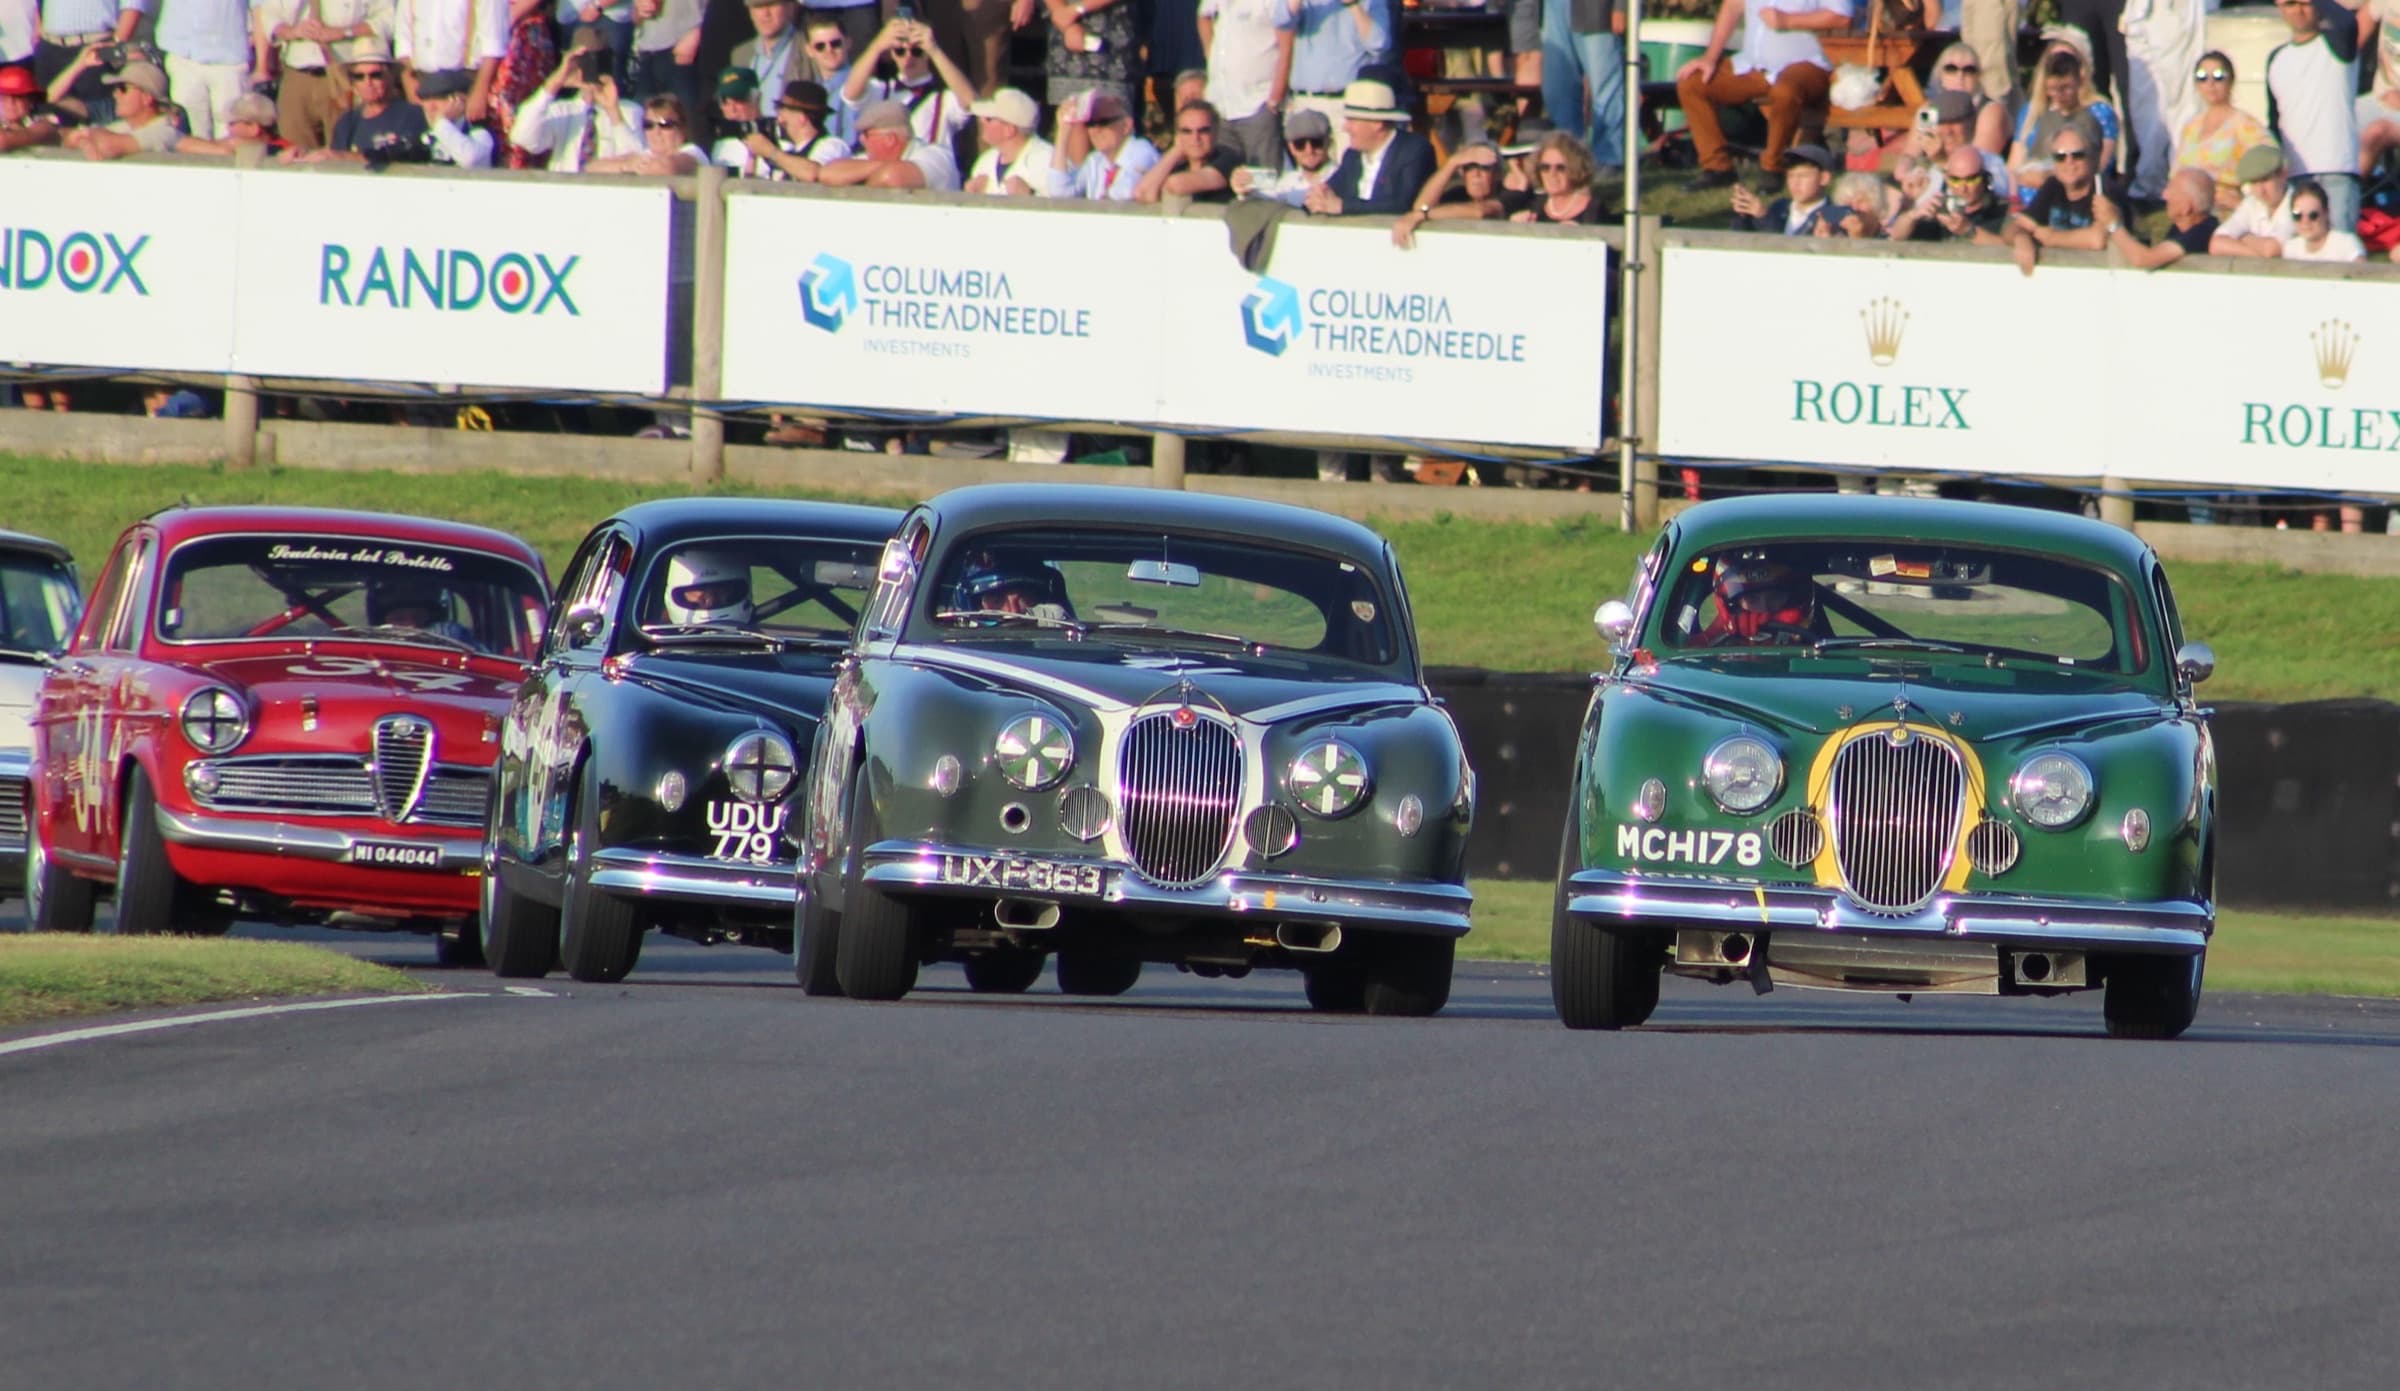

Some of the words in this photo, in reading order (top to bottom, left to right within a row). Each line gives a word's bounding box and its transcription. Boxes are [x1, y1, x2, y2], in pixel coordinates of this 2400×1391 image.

[319, 243, 581, 316] RANDOX
[863, 265, 1012, 300] COLUMBIA
[864, 299, 1091, 337] THREADNEEDLE
[1309, 289, 1452, 323] COLUMBIA
[863, 339, 971, 358] INVESTMENTS
[1309, 323, 1526, 362] THREADNEEDLE
[1308, 362, 1413, 383] INVESTMENTS
[1792, 379, 1971, 430] ROLEX
[268, 544, 348, 561] Scuderia
[351, 548, 381, 563] del
[384, 551, 452, 571] Portello
[706, 801, 781, 834] UDU
[710, 829, 772, 862] 779
[1617, 824, 1762, 866] MCH178
